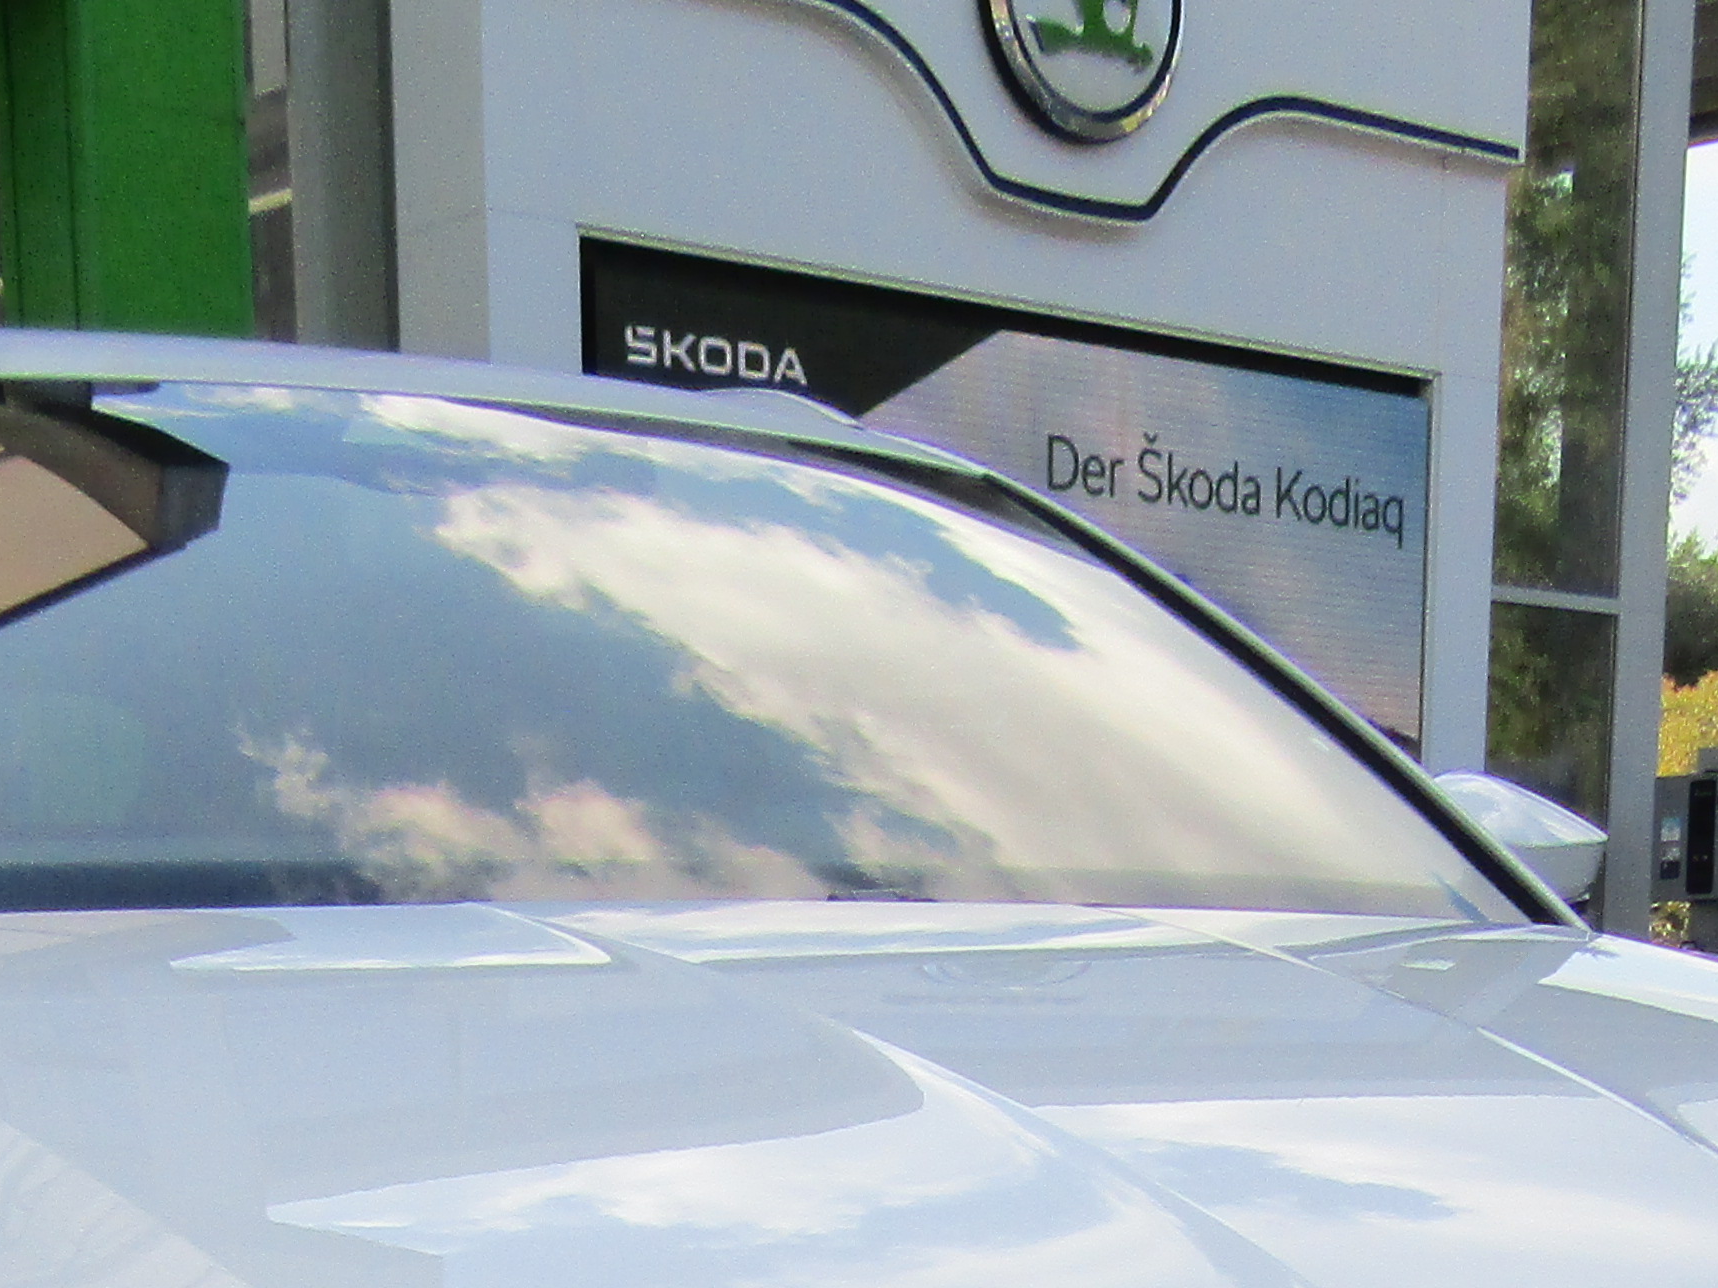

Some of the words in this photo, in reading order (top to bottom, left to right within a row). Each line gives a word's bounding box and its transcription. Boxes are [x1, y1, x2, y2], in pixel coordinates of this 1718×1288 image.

[1046, 433, 1125, 498] Der
[1137, 431, 1261, 516] Škoda
[1276, 466, 1403, 549] Kodiaq
